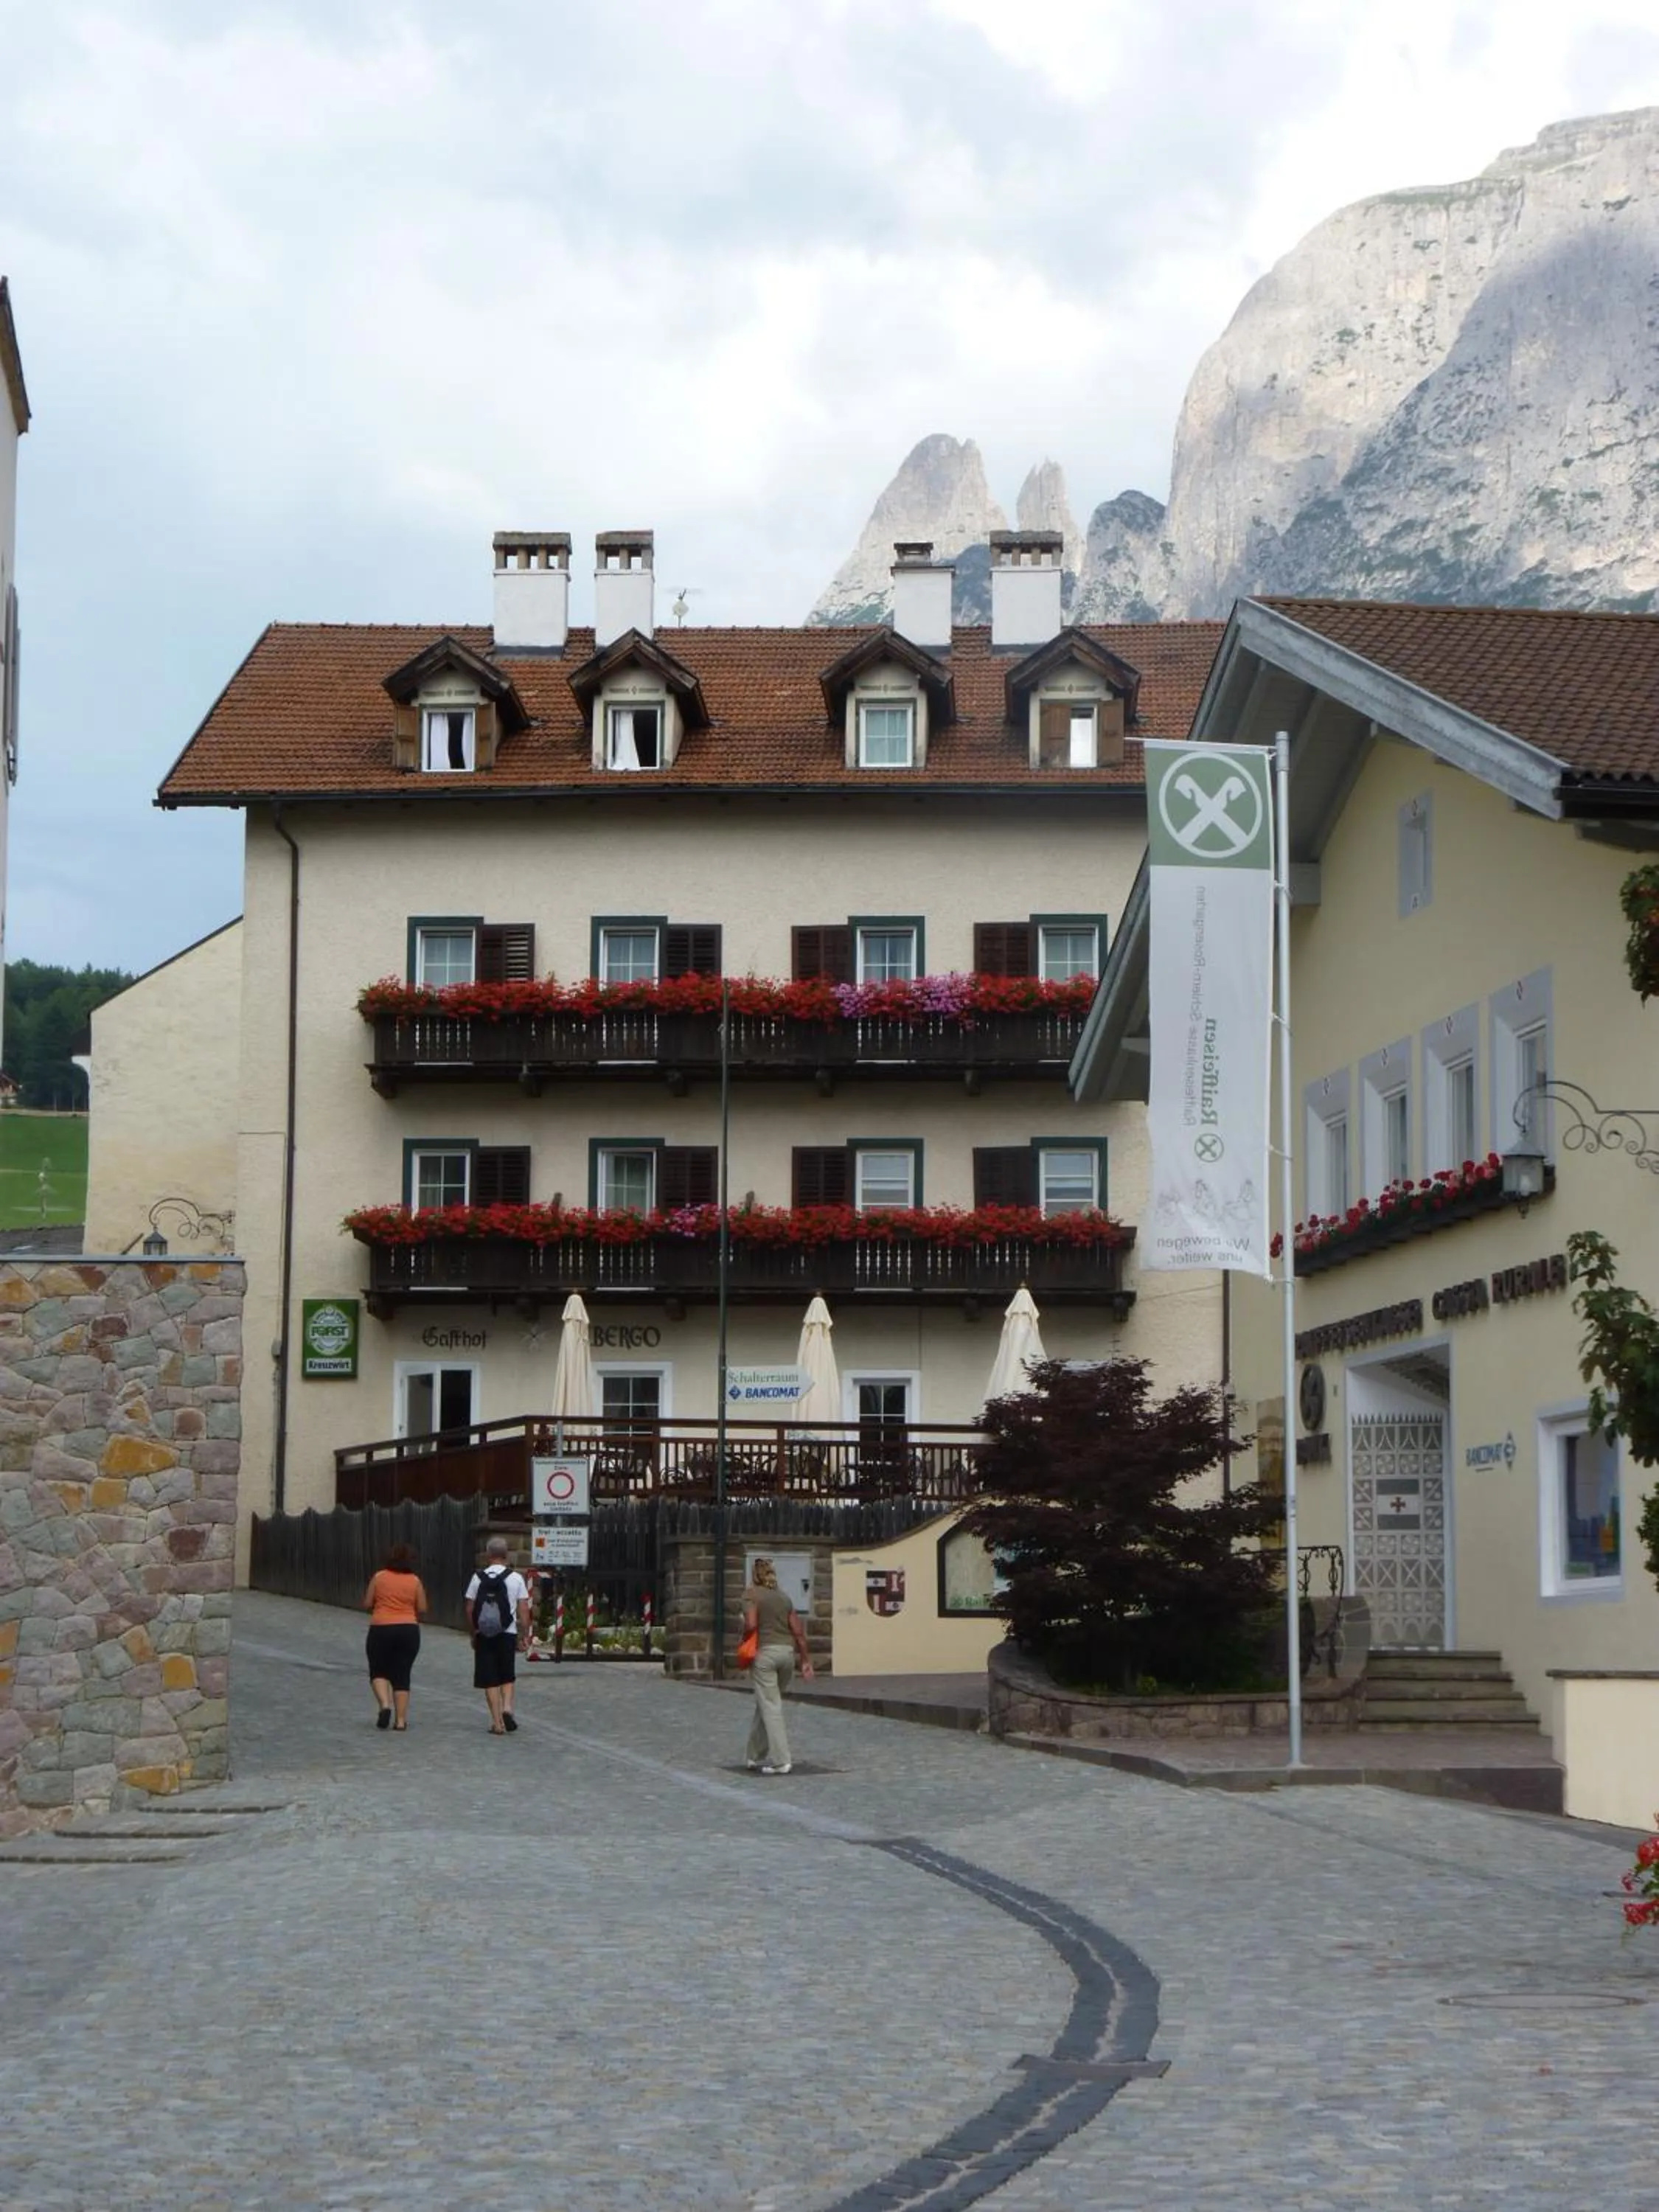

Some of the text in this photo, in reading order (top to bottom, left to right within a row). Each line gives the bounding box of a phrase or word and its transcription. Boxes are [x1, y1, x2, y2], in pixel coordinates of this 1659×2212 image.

[311, 1326, 347, 1337] FORST
[591, 1326, 661, 1349] BERGO
[308, 1360, 349, 1369] Kreuzwirt
[728, 1372, 799, 1383] Schalterraum
[745, 1388, 801, 1398] BANCOMAT
